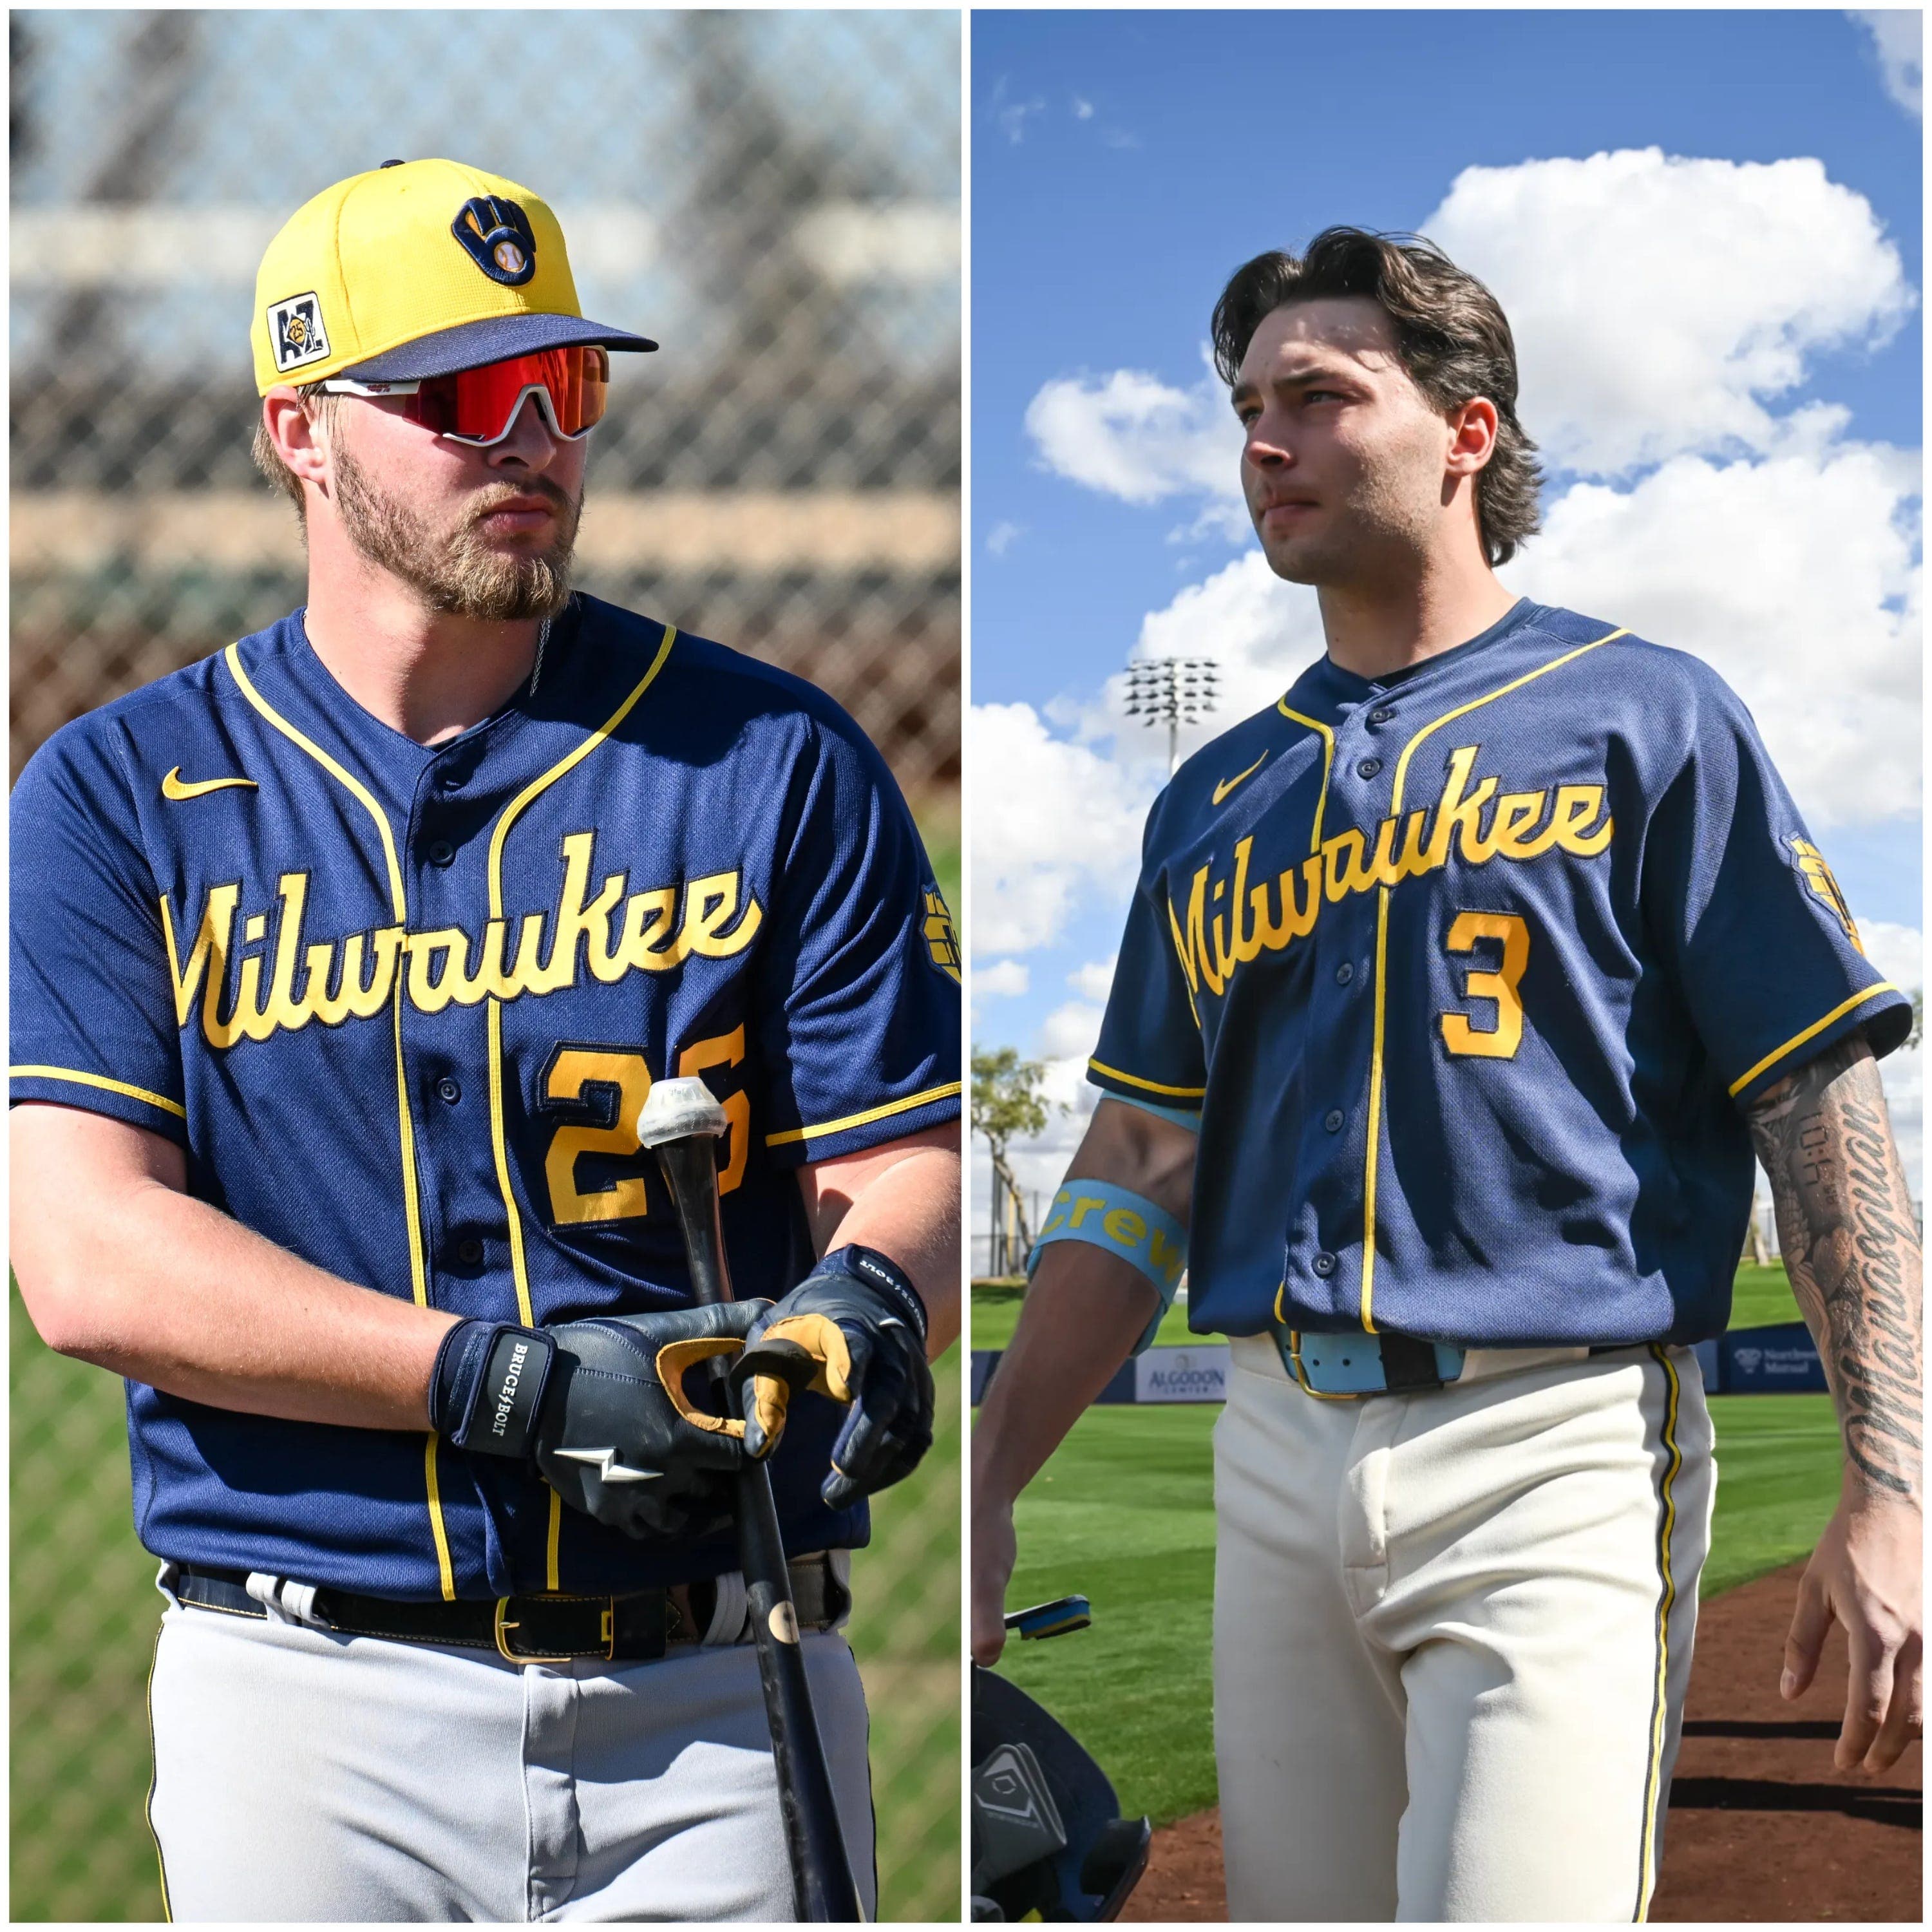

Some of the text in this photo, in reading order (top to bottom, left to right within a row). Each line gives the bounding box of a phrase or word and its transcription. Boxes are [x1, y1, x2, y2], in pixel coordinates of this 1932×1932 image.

[277, 299, 323, 365] AZ
[290, 321, 305, 342] 25
[366, 384, 391, 393] 100%
[1166, 744, 1615, 997] Milwaukee
[159, 829, 764, 1050] Milwaukee
[1440, 908, 1531, 1061] 3
[1042, 1190, 1186, 1283] crew
[1840, 1102, 1923, 1493] Manasquan
[492, 1343, 529, 1437] BRUCE BOLT
